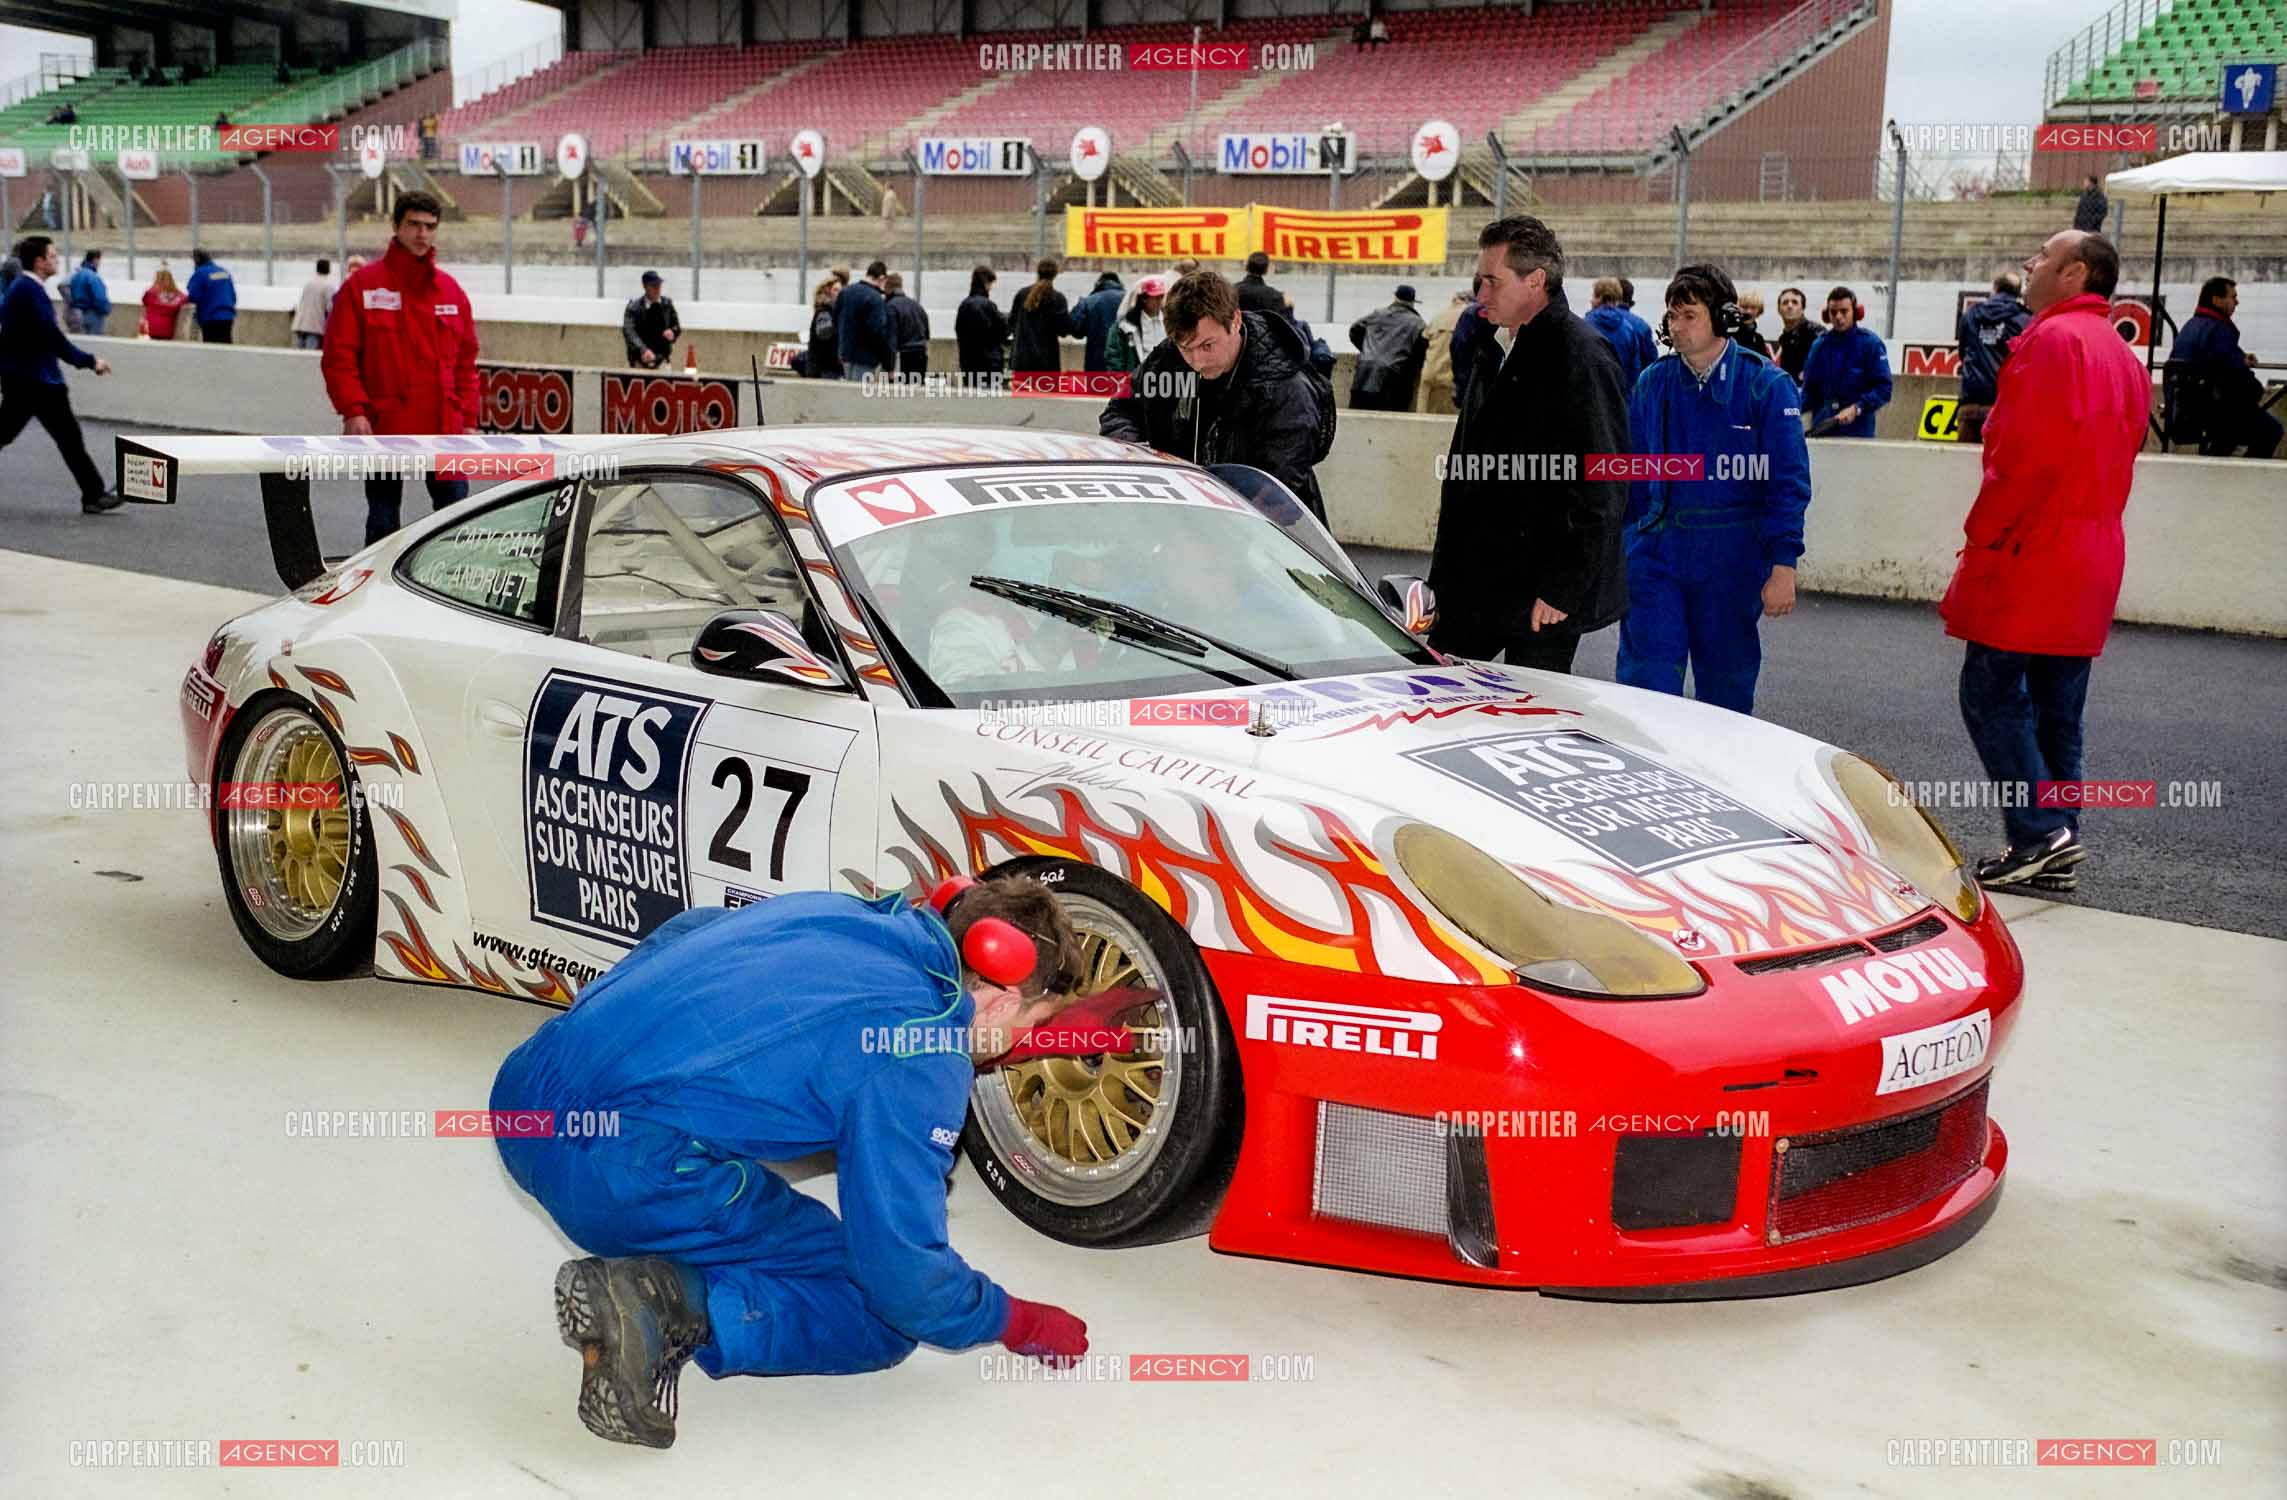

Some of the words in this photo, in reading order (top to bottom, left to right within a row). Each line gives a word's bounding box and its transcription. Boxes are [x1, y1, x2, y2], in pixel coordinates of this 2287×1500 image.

[924, 141, 991, 171] Mobil
[1223, 138, 1306, 170] Mobil
[1084, 211, 1229, 256] PIRELLI
[1263, 211, 1423, 260] PIRELLI
[604, 377, 737, 435] MOTO
[554, 484, 574, 517] 3
[946, 473, 1186, 505] PIRELLI
[550, 691, 672, 791] ATS
[976, 719, 1108, 761] CONSEIL
[1119, 748, 1260, 800] CAPITAL
[1468, 736, 1625, 786] ATS
[535, 775, 674, 850] ASCENSEURS
[1516, 767, 1701, 814] ASCENSEURS
[1555, 801, 1643, 838] SUR
[1629, 789, 1742, 827] MESURE
[708, 757, 811, 882] 27
[1645, 816, 1740, 850] PARIS
[536, 821, 581, 873] SUR
[585, 833, 680, 899] MESURE
[578, 877, 641, 934] PARIS
[1818, 947, 1990, 1026] MOTUL
[1245, 993, 1444, 1061] PIRELLI
[1887, 1017, 1989, 1083] ACTEON
